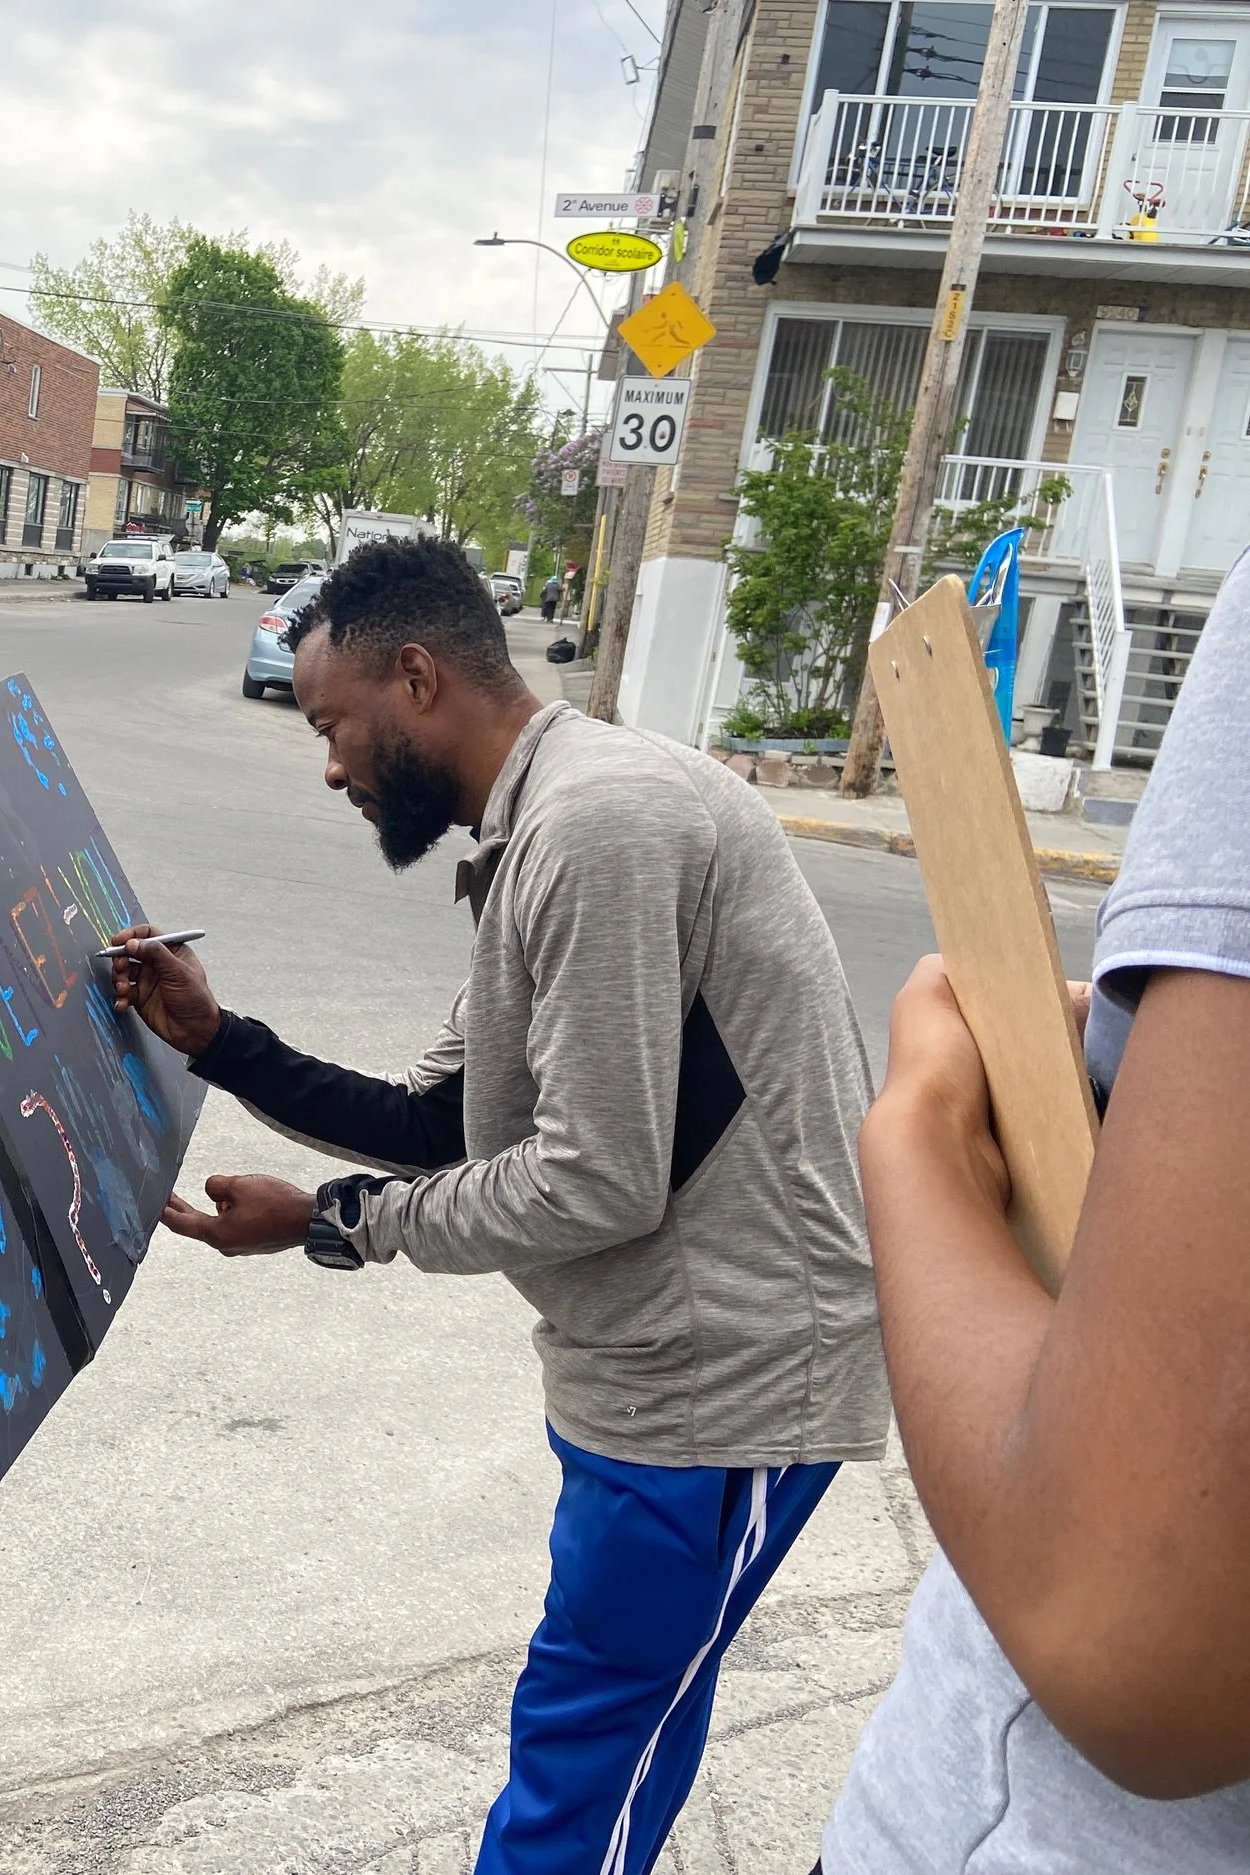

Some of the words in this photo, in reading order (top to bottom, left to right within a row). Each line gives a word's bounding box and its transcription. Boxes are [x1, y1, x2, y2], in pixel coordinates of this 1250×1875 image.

[578, 199, 629, 212] Avenue
[574, 242, 614, 257] Corridor
[616, 246, 654, 261] scolaire
[624, 390, 685, 405] MAXIMUM
[619, 413, 676, 453] 30
